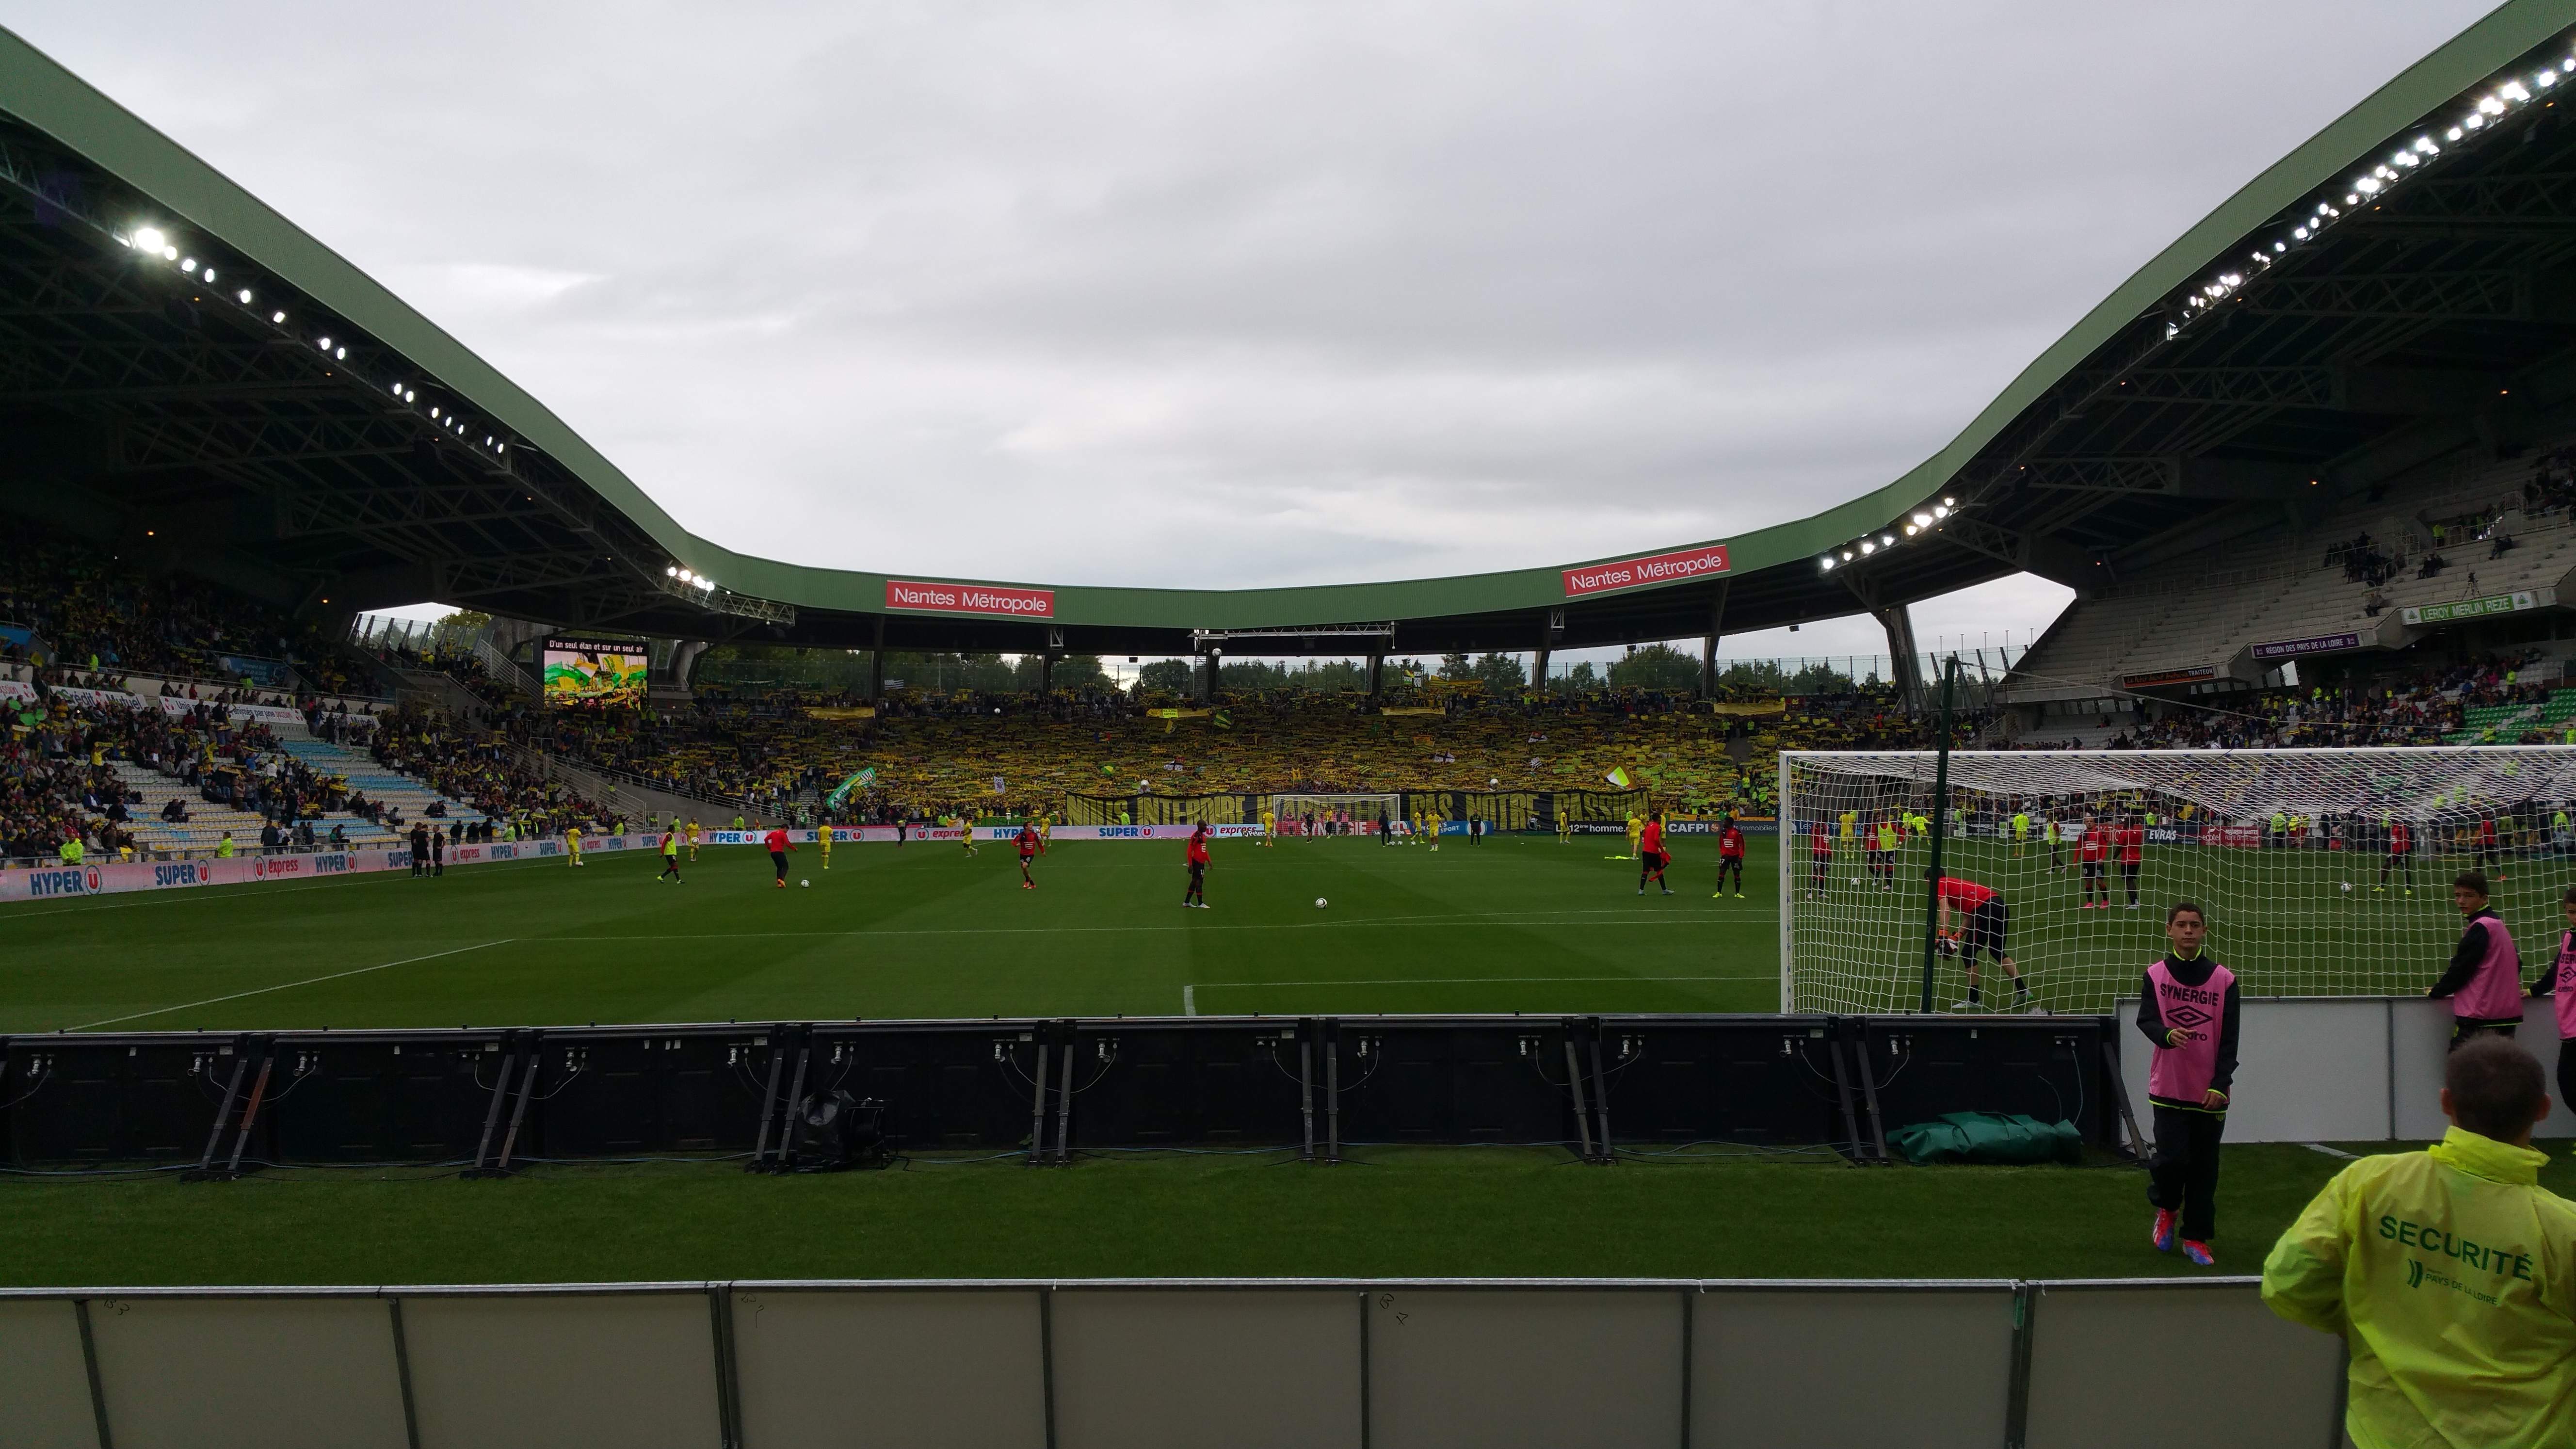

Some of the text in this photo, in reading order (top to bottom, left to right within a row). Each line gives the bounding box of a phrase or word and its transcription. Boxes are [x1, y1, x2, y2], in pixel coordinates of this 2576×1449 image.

[1571, 569, 1631, 590] Nantes
[894, 587, 955, 605] Nantes
[2423, 598, 2510, 620] LEROY MERLIN REZE
[549, 640, 563, 648] D'un
[2266, 644, 2285, 654] RÉGION
[2297, 643, 2310, 651] PAYS
[2328, 638, 2344, 647] LOIRE
[2188, 668, 2213, 676] TRAITEUR
[1067, 794, 1128, 825] NOUS
[1466, 793, 1539, 830] NOTRE
[1099, 827, 1138, 837] SUPER
[1668, 823, 1709, 832] CAFPI
[2149, 830, 2176, 840] EVRAS
[608, 838, 622, 849] HYPER
[642, 835, 658, 846] SUPER
[709, 833, 741, 843] HYPER
[807, 831, 848, 841] SUER
[491, 845, 517, 859] HYPER U
[539, 841, 562, 855] SUPER U
[587, 840, 601, 851] express
[315, 854, 354, 872] HYPER U
[388, 851, 413, 868] SUPER
[452, 849, 480, 862] U express
[155, 864, 208, 886] SUPER U
[256, 859, 298, 877] U express
[30, 871, 97, 895] HYPER U
[2160, 983, 2219, 1007] SYNERGIE
[2379, 1215, 2533, 1281] SECURITÉ
[2426, 1273, 2497, 1305] PAYS DE LA LOIRE
